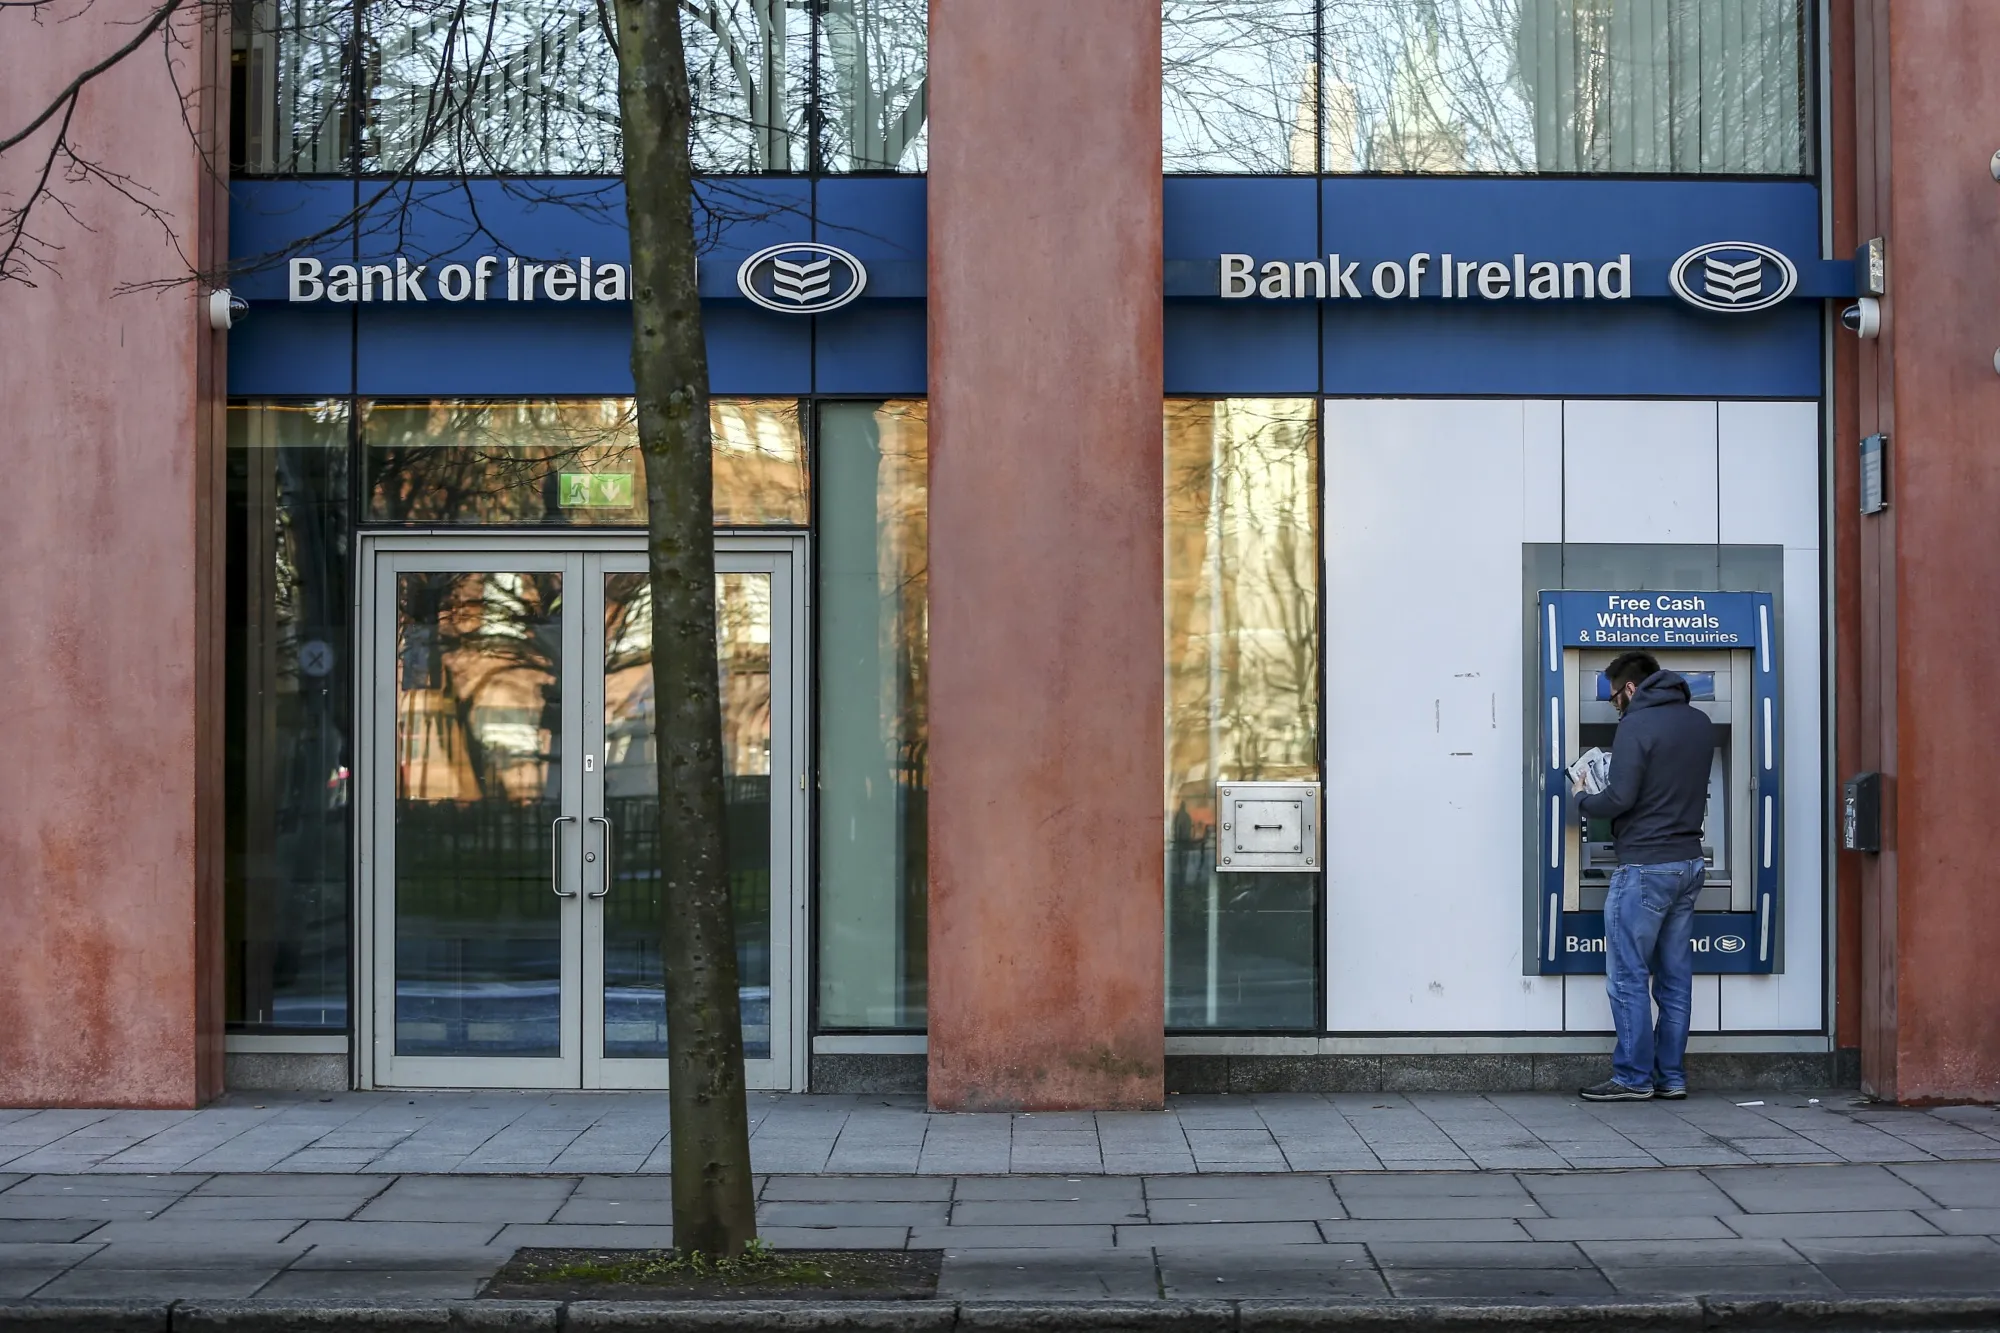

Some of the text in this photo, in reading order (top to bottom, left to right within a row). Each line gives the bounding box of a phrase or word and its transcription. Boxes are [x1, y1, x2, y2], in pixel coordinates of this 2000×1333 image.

[289, 255, 698, 302] Bank of Irela
[1220, 252, 1631, 300] Bank of Ireland
[1608, 596, 1705, 611] Free Cash
[1596, 613, 1719, 628] Withdrawals
[1579, 630, 1738, 645] & Balance Enquiries
